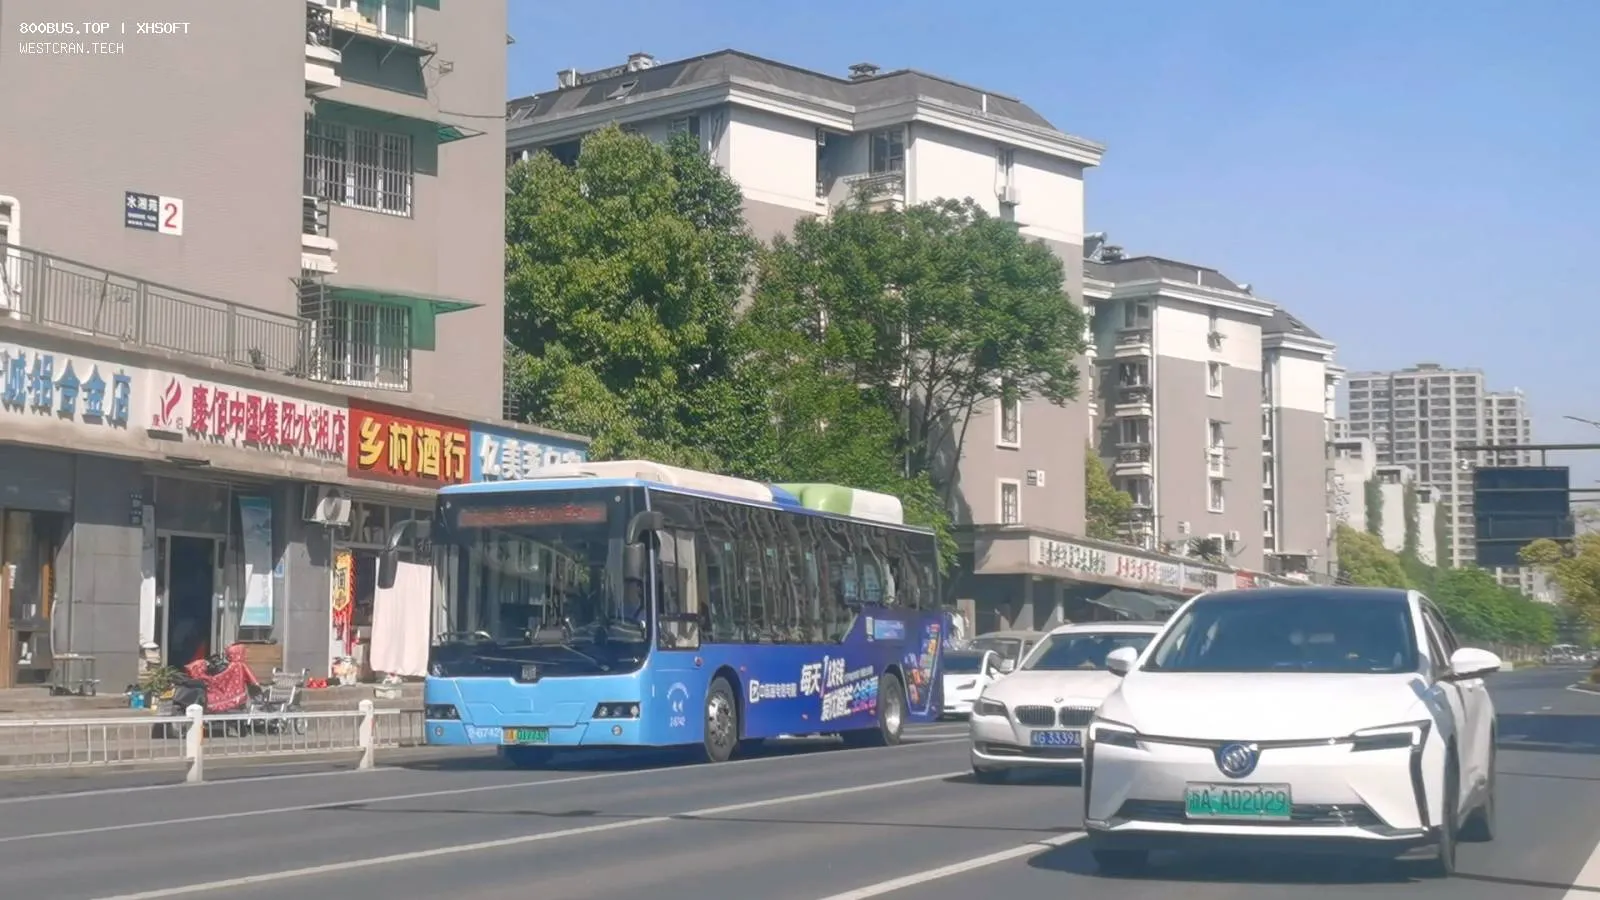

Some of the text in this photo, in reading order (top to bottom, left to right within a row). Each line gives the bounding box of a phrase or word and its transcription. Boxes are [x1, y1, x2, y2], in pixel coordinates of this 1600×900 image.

[164, 203, 178, 228] 2
[359, 416, 467, 480] 乡村酒行
